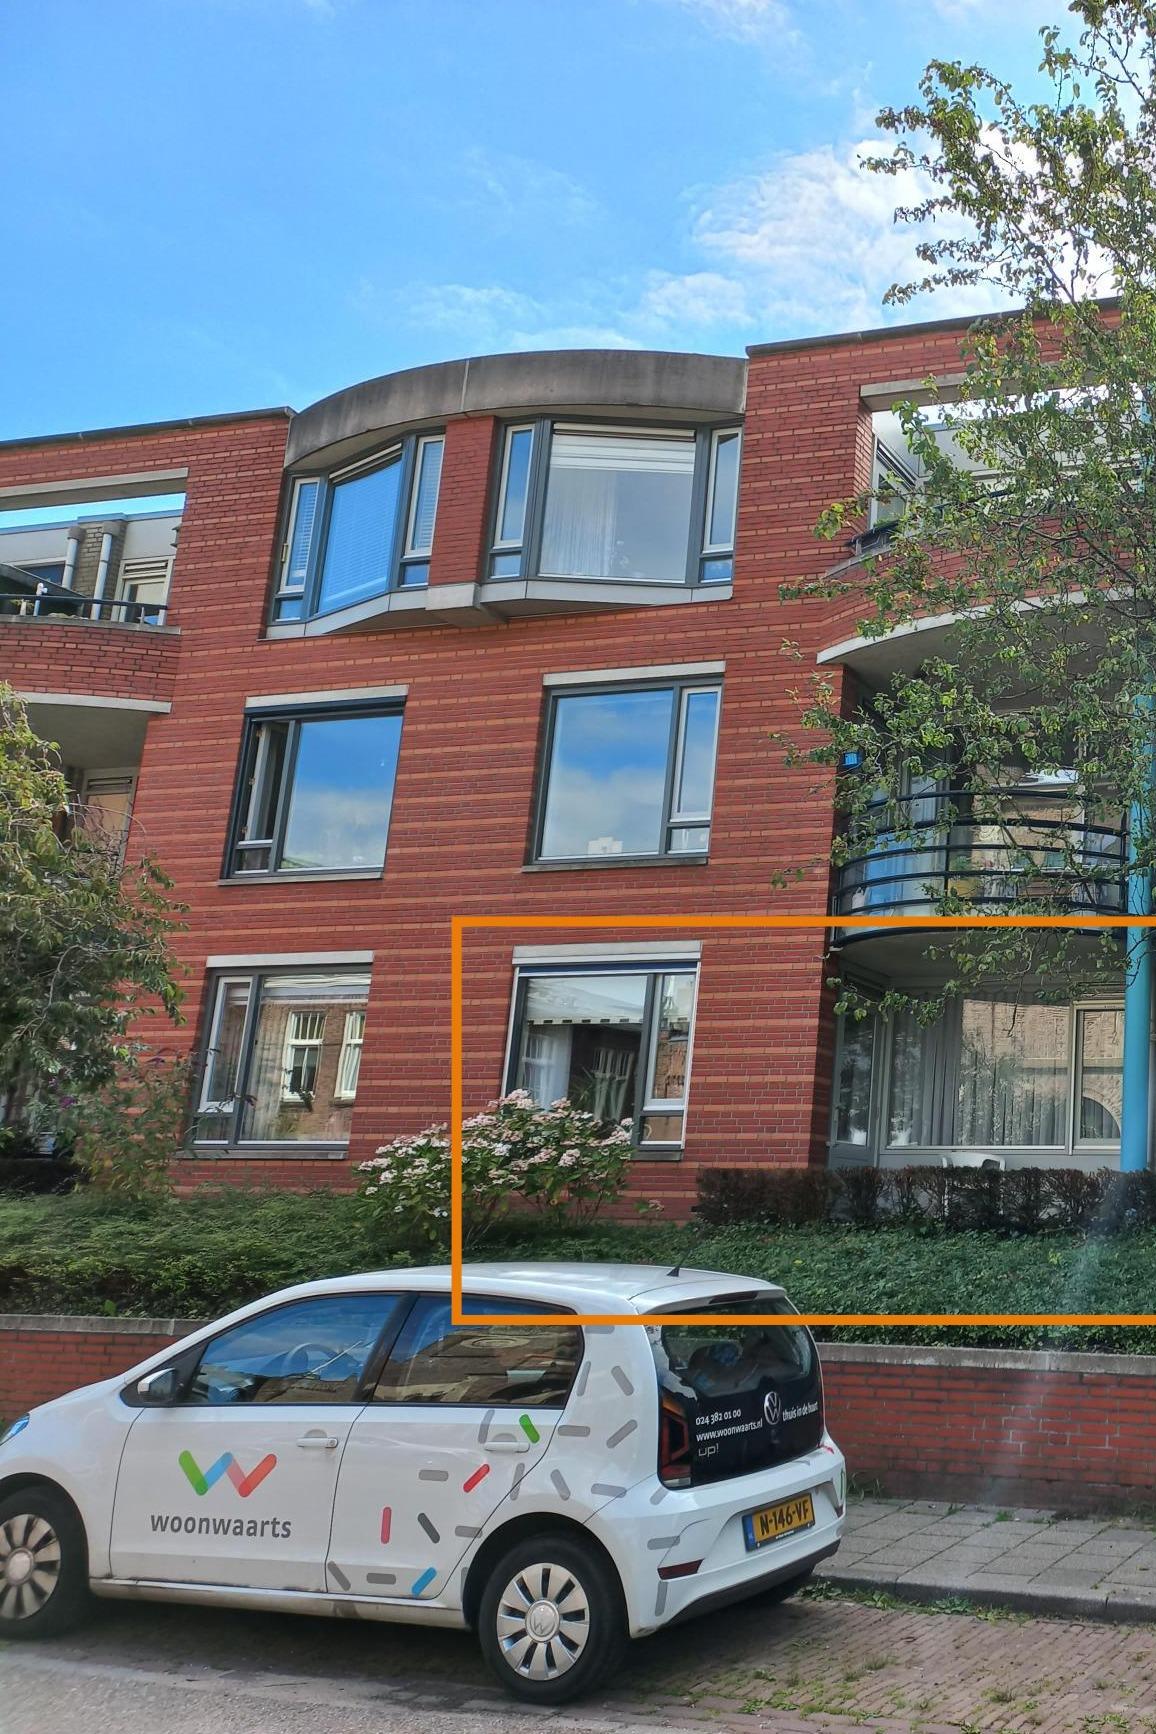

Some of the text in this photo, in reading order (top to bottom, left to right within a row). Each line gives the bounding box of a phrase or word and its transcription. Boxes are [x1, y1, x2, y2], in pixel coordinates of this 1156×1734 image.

[696, 1409, 741, 1425] 024 382 01 00
[696, 1417, 763, 1442] www.woonwaarts.nl
[699, 1443, 719, 1457] up!
[150, 1514, 292, 1539] woonwaarts
[760, 1499, 809, 1536] N-146-VF
